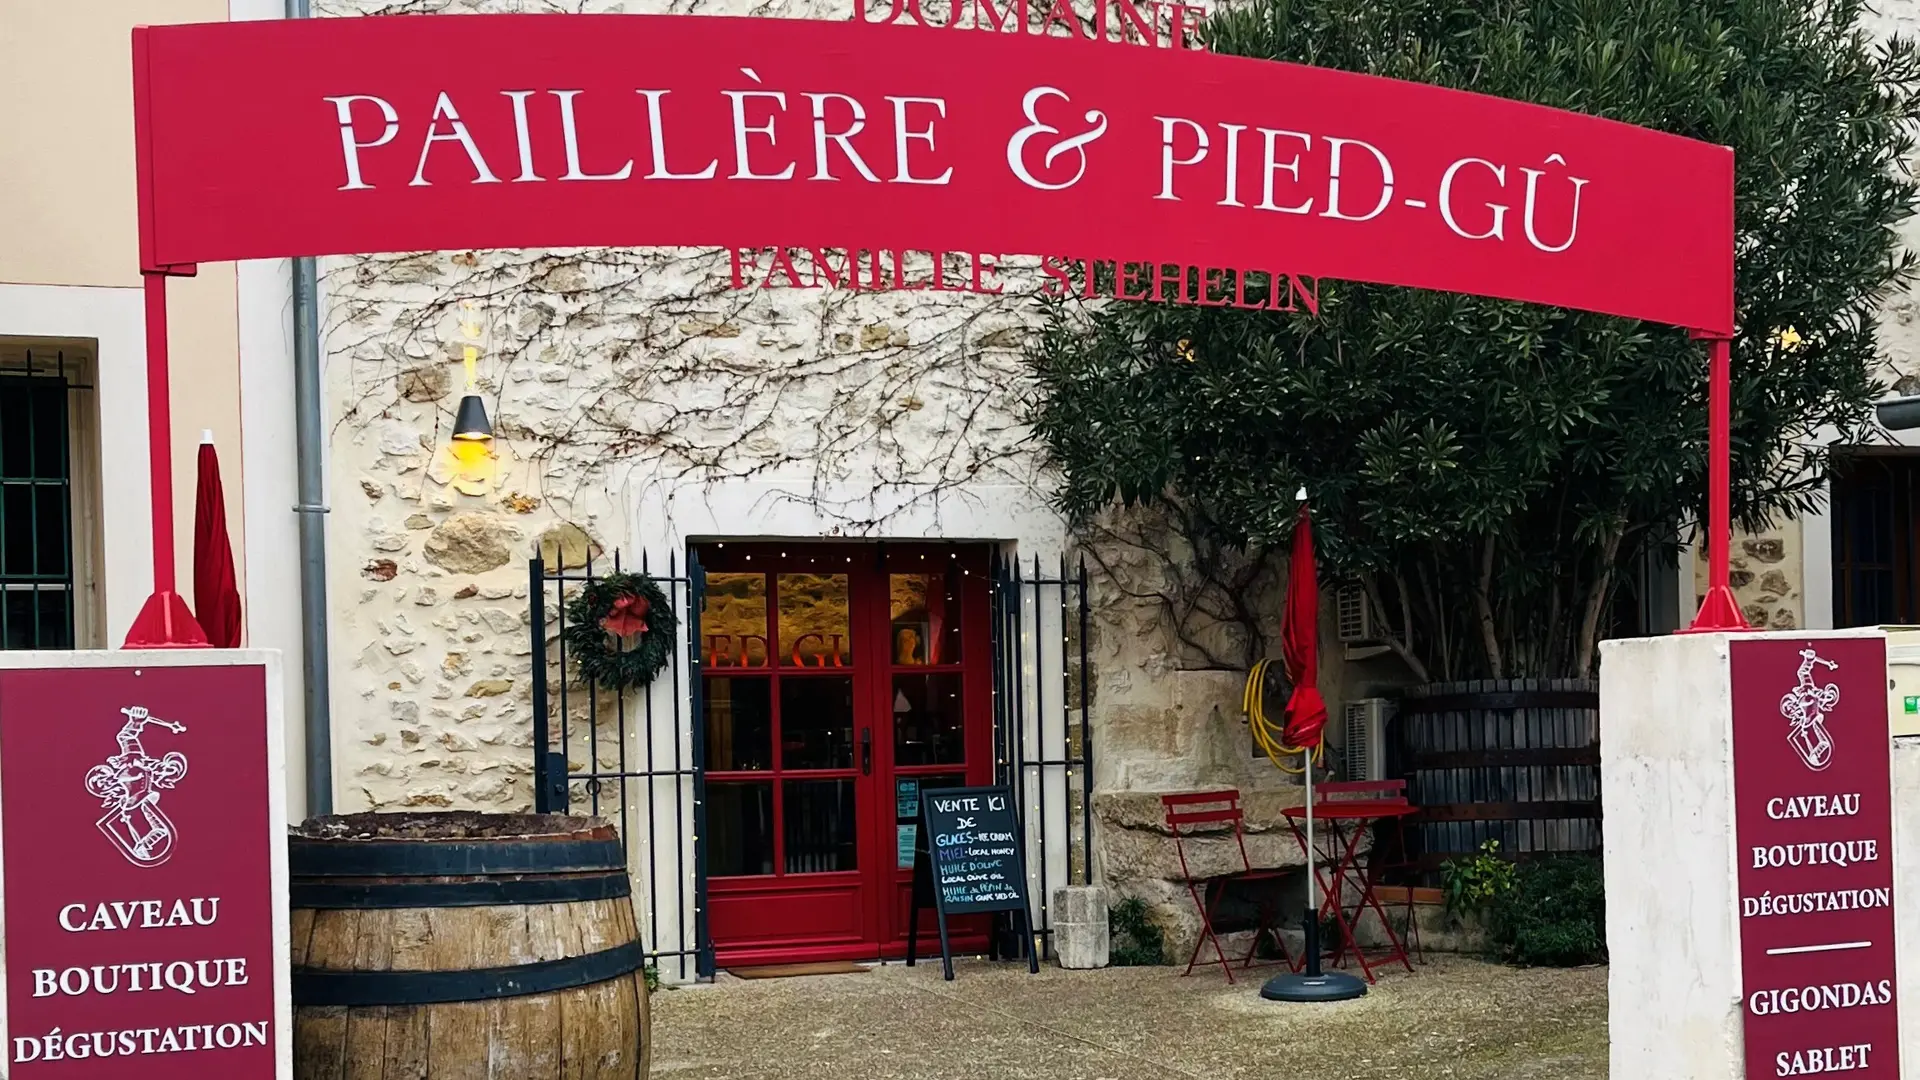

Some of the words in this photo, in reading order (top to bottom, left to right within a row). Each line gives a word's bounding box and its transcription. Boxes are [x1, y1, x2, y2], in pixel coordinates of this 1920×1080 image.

[323, 67, 954, 191] PAILLÈRE
[1006, 86, 1108, 190] &
[1152, 114, 1590, 253] PIED-GÛ
[730, 247, 1004, 295] FAMILLE
[1042, 255, 1322, 316] STEHELIN
[934, 798, 980, 813] VENTE
[987, 795, 1006, 812] ICI
[1766, 794, 1861, 820] CAVEAU
[956, 817, 977, 830] DE
[1752, 840, 1878, 869] BOUTIQUE
[941, 876, 967, 884] LOCAL
[58, 897, 220, 933] CAVEAU
[1743, 887, 1890, 917] DÉGUSTATION
[32, 958, 249, 998] BOUTIQUE
[1749, 980, 1892, 1016] GIGONDAS
[13, 1021, 269, 1063] DÉGUSTATION
[1776, 1043, 1871, 1077] SABLET
